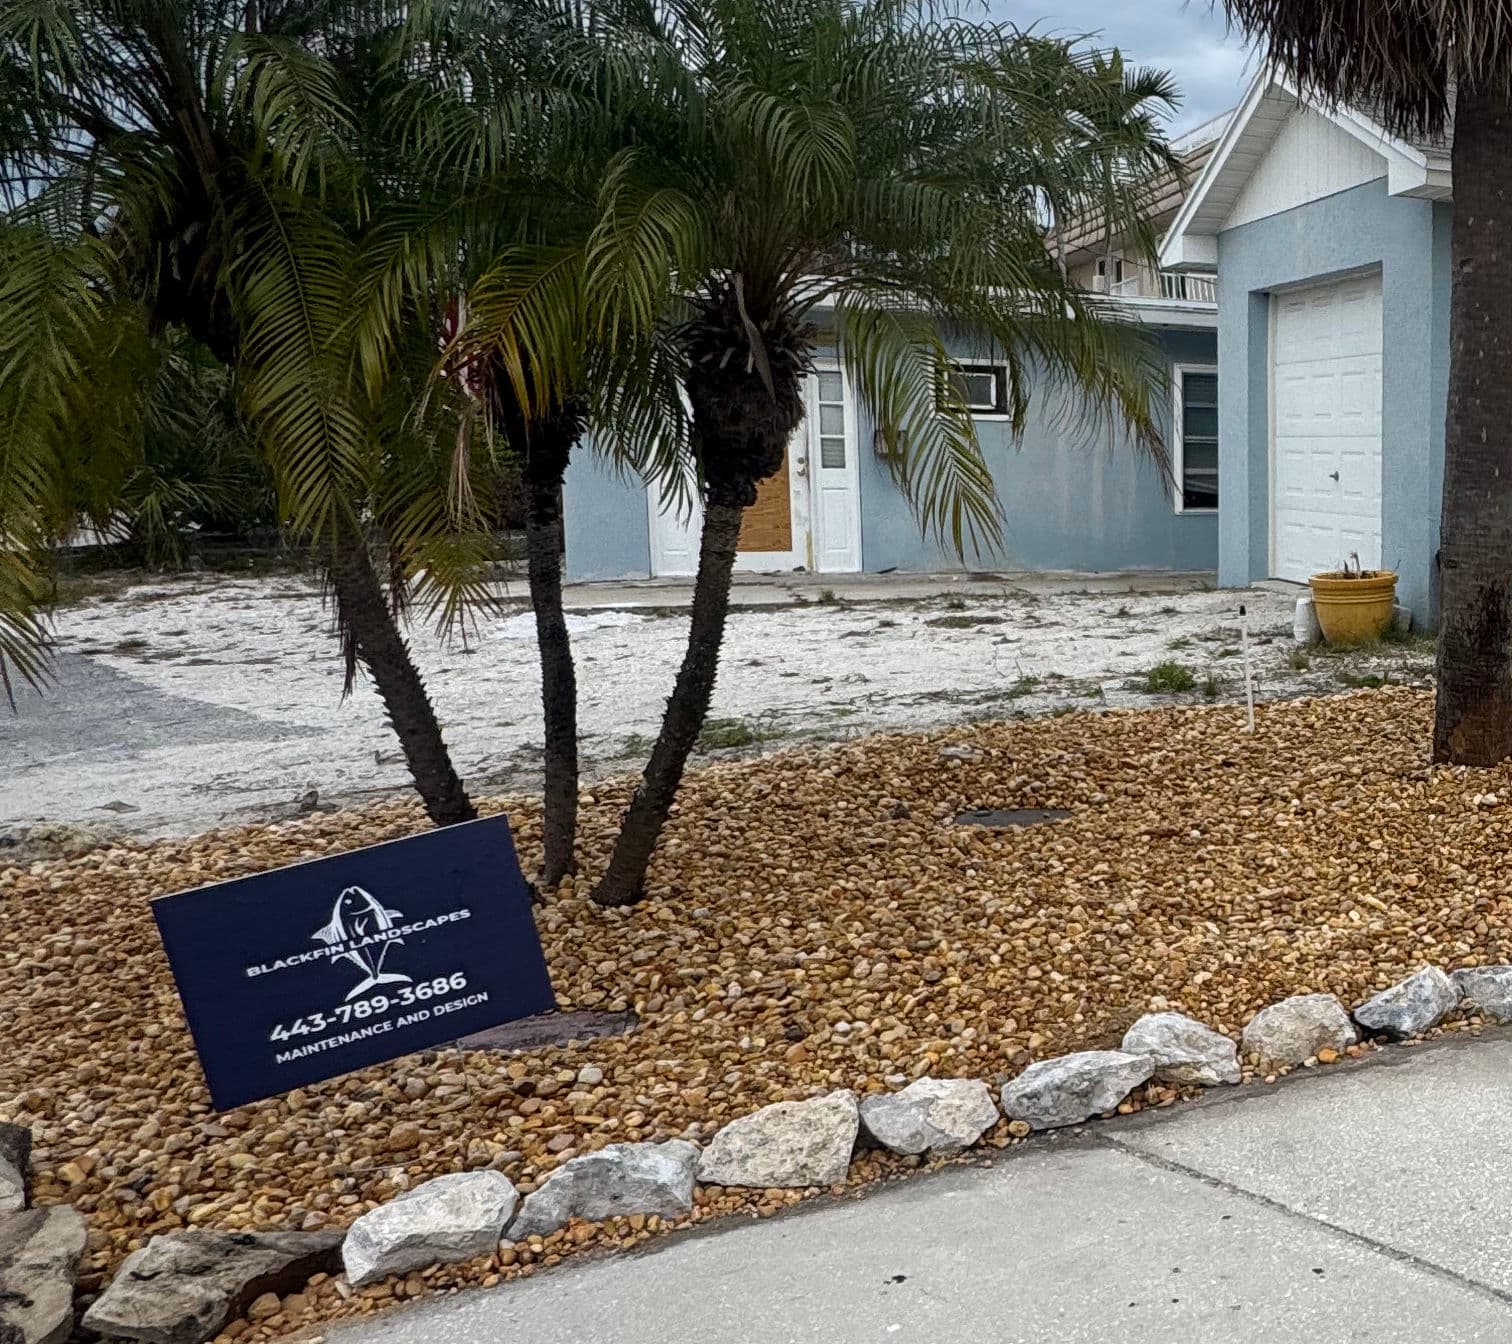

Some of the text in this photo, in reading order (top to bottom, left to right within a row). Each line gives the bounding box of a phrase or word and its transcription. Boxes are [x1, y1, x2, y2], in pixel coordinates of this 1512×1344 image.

[246, 909, 471, 977] BLACKFIN LANDSCAPES
[269, 972, 467, 1042] 443-789-3686
[276, 992, 489, 1064] MAINTENANCE AND DESIGN
